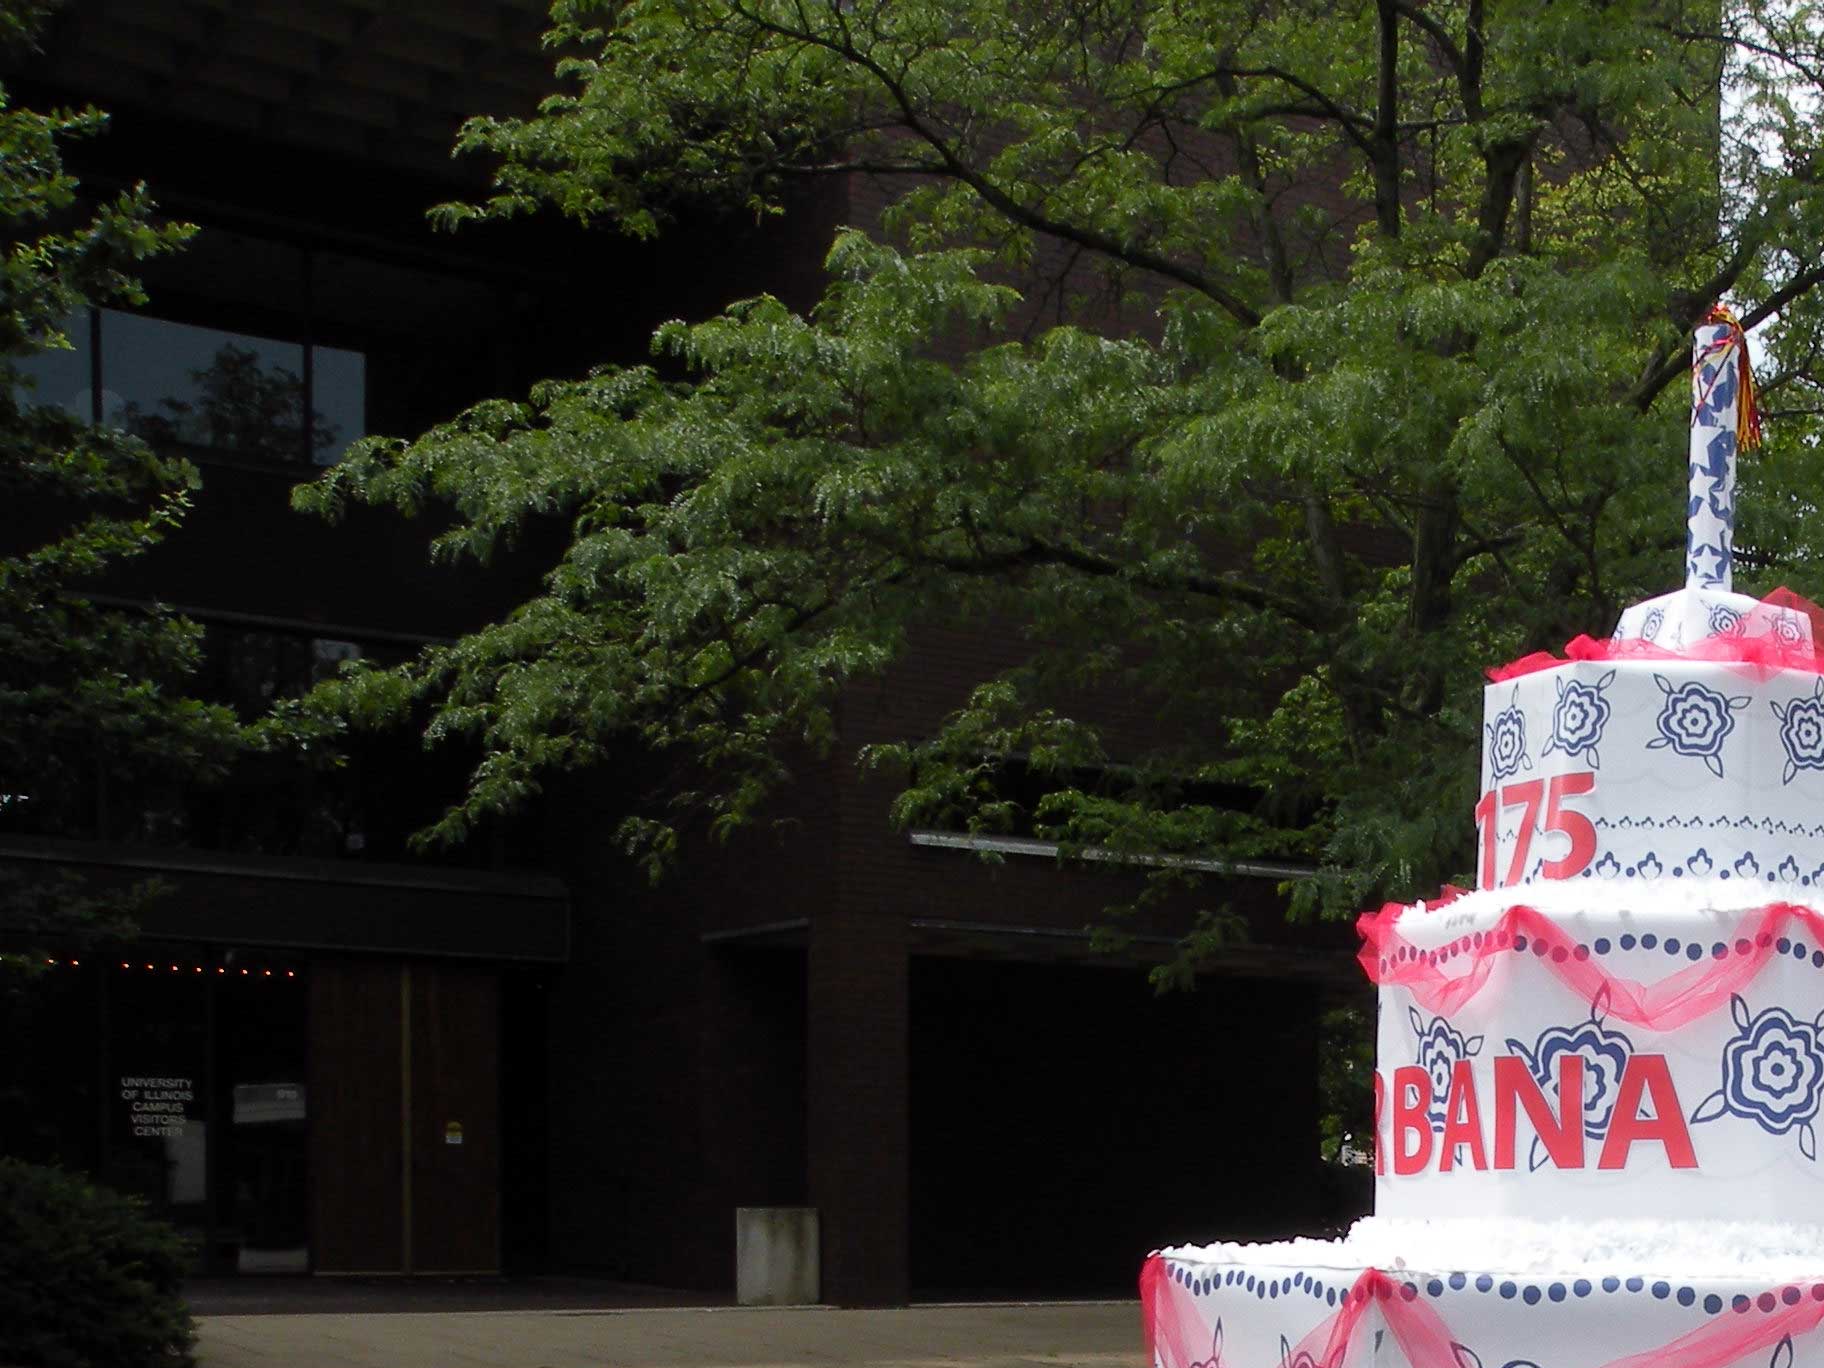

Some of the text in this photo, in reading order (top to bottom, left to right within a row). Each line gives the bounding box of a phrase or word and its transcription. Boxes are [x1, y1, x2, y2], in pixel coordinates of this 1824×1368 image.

[1475, 772, 1598, 892] 175
[121, 1077, 192, 1089] UNIVERSITY
[121, 1089, 193, 1101] OF ILLINOIS
[132, 1102, 184, 1113] CAMPUS
[131, 1113, 186, 1125] VISITORS
[134, 1126, 183, 1137] CENTER
